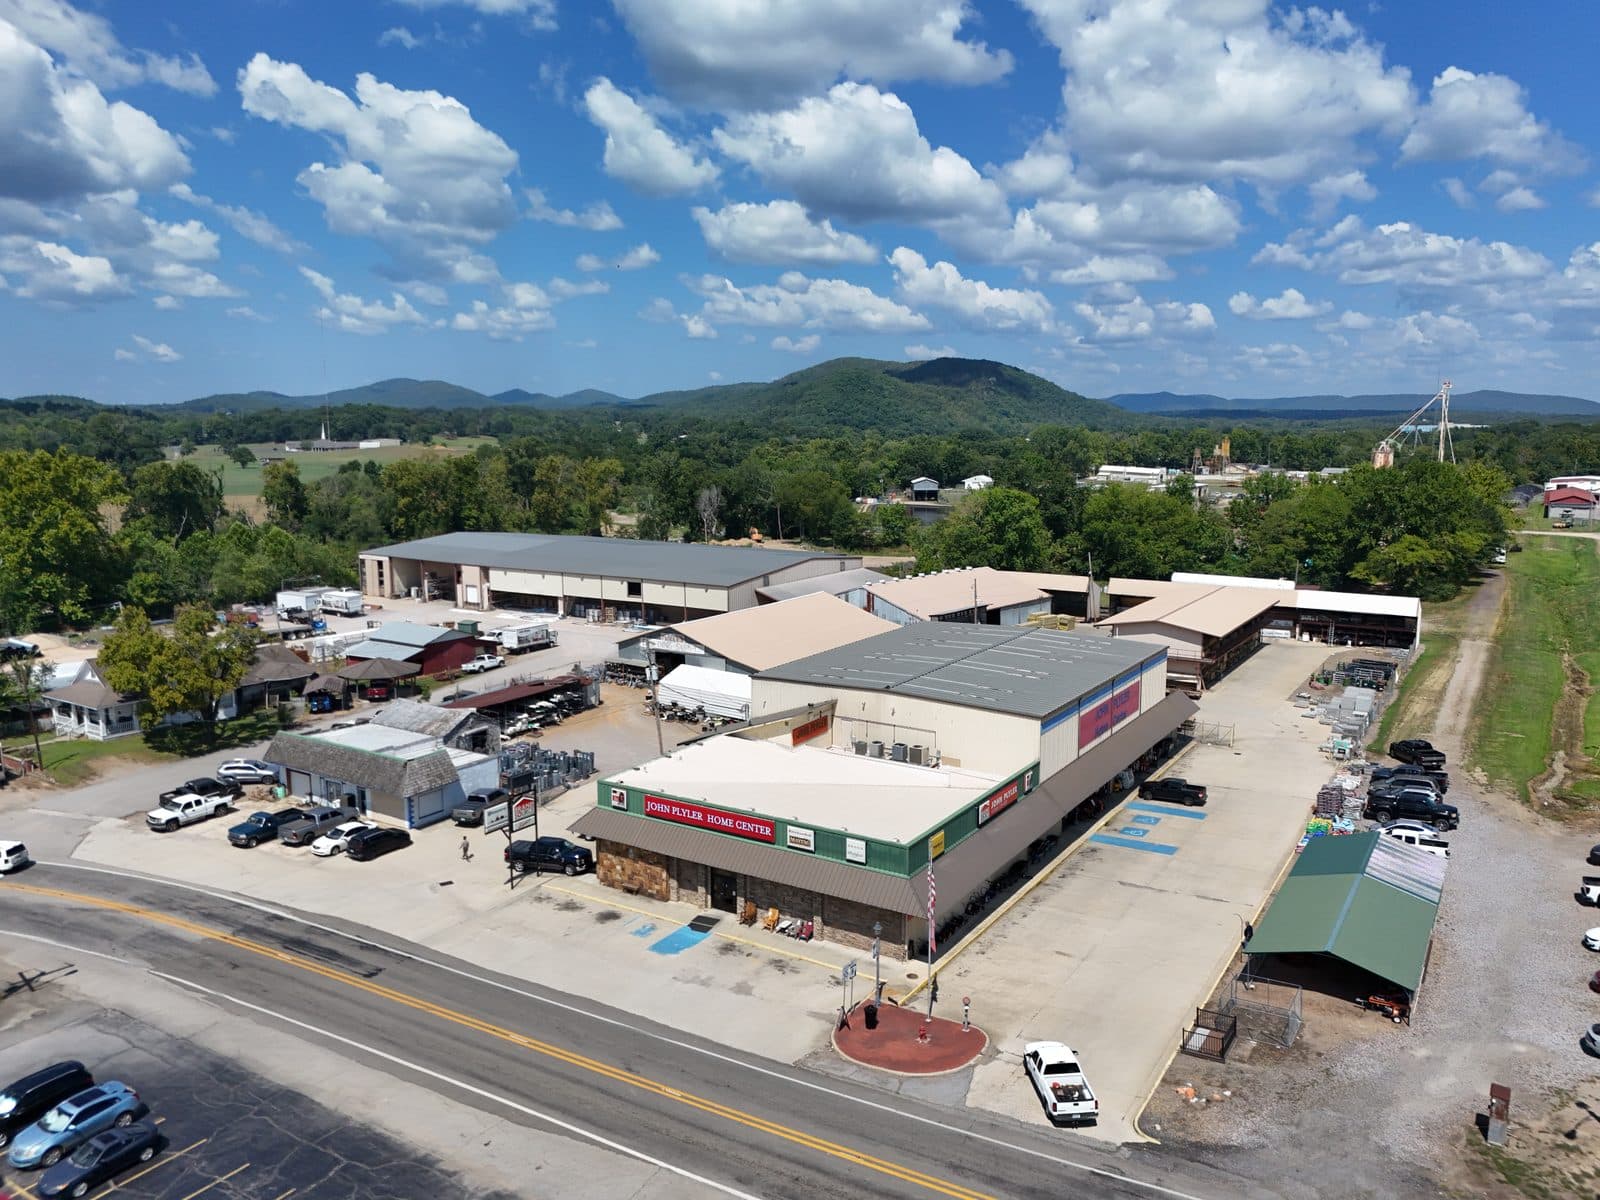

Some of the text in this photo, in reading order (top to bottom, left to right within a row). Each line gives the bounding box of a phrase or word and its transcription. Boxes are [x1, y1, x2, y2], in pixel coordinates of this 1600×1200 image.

[991, 796, 1003, 809] JOHN
[646, 801, 771, 836] JOHN PLYLER HOME CENTER
